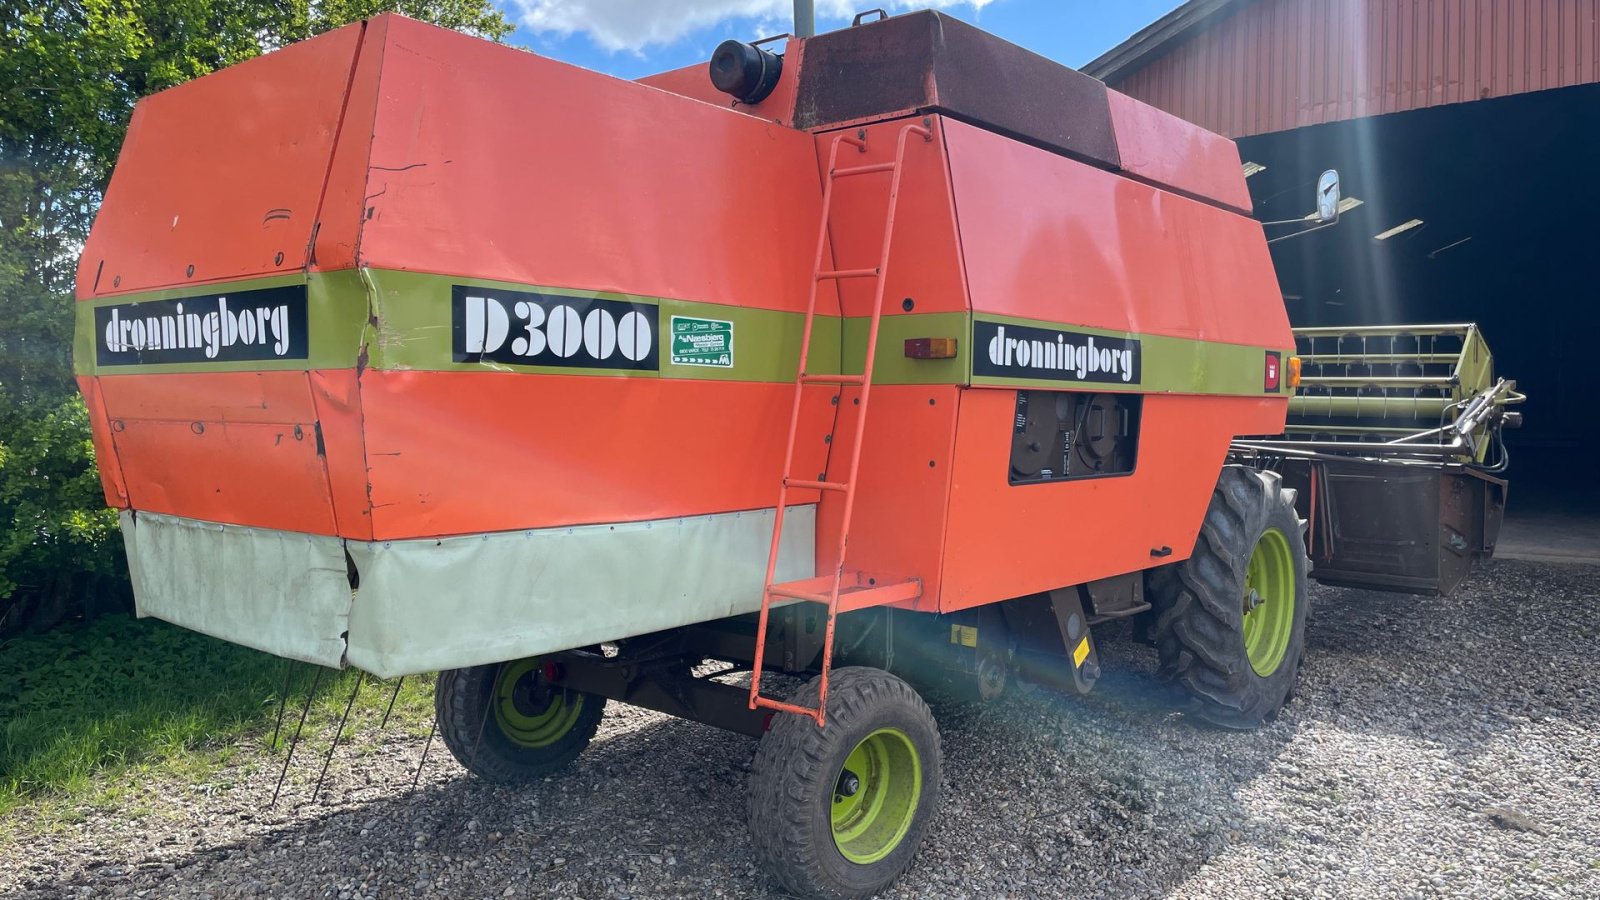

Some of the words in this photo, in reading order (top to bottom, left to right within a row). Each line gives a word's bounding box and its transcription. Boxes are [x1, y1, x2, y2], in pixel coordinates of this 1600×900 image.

[105, 297, 289, 359] dronningborg
[465, 296, 652, 361] D3000
[988, 326, 1132, 382] dronningborg
